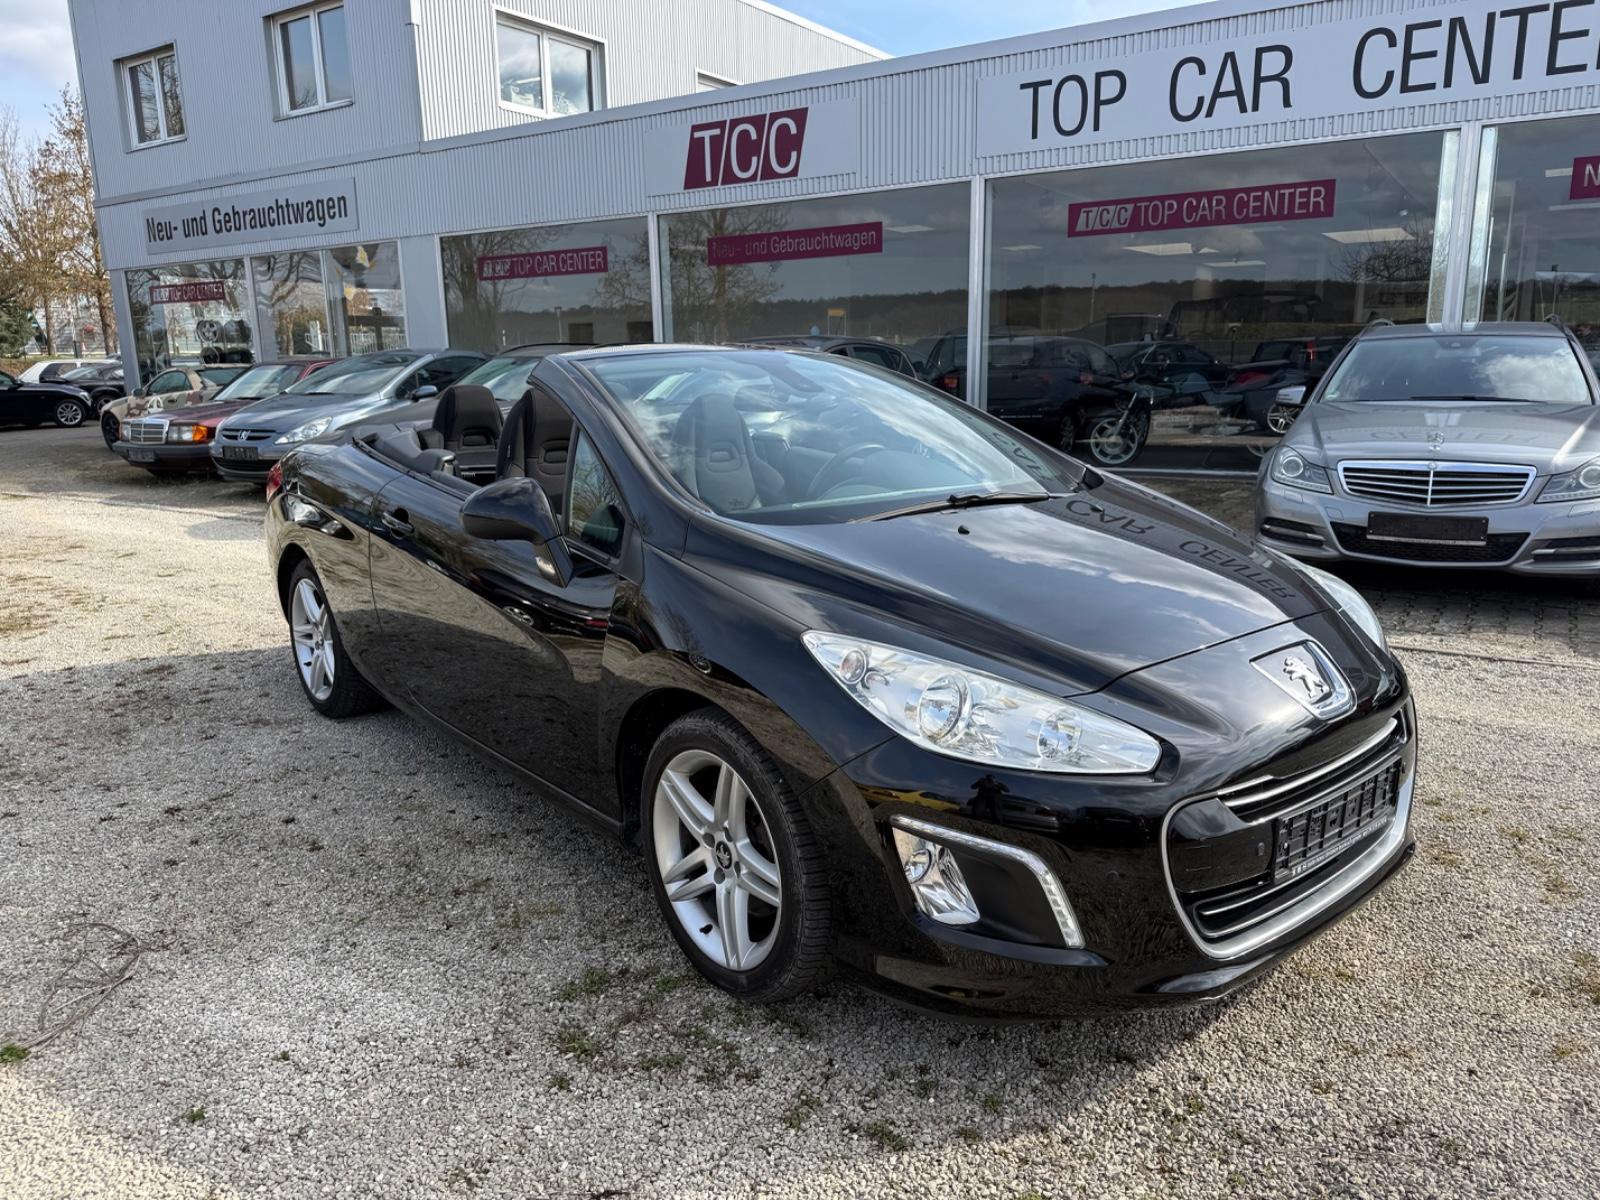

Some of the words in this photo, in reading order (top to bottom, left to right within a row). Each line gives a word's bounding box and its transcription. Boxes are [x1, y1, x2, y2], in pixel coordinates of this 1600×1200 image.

[1019, 69, 1127, 140] TOP
[1169, 44, 1293, 122] CAR
[1352, 0, 1600, 99] CENTE
[146, 217, 178, 243] Neu-
[182, 209, 208, 238] und
[212, 194, 348, 235] Gebrauchtwagen
[1136, 200, 1178, 226] TOP
[1183, 196, 1227, 224] CAR
[1232, 186, 1326, 219] CENTER
[511, 257, 533, 275] TOP
[534, 254, 558, 273] CAR
[559, 250, 605, 272] CENTER
[745, 238, 768, 256] und
[770, 230, 877, 254] Gebrauchtwagen
